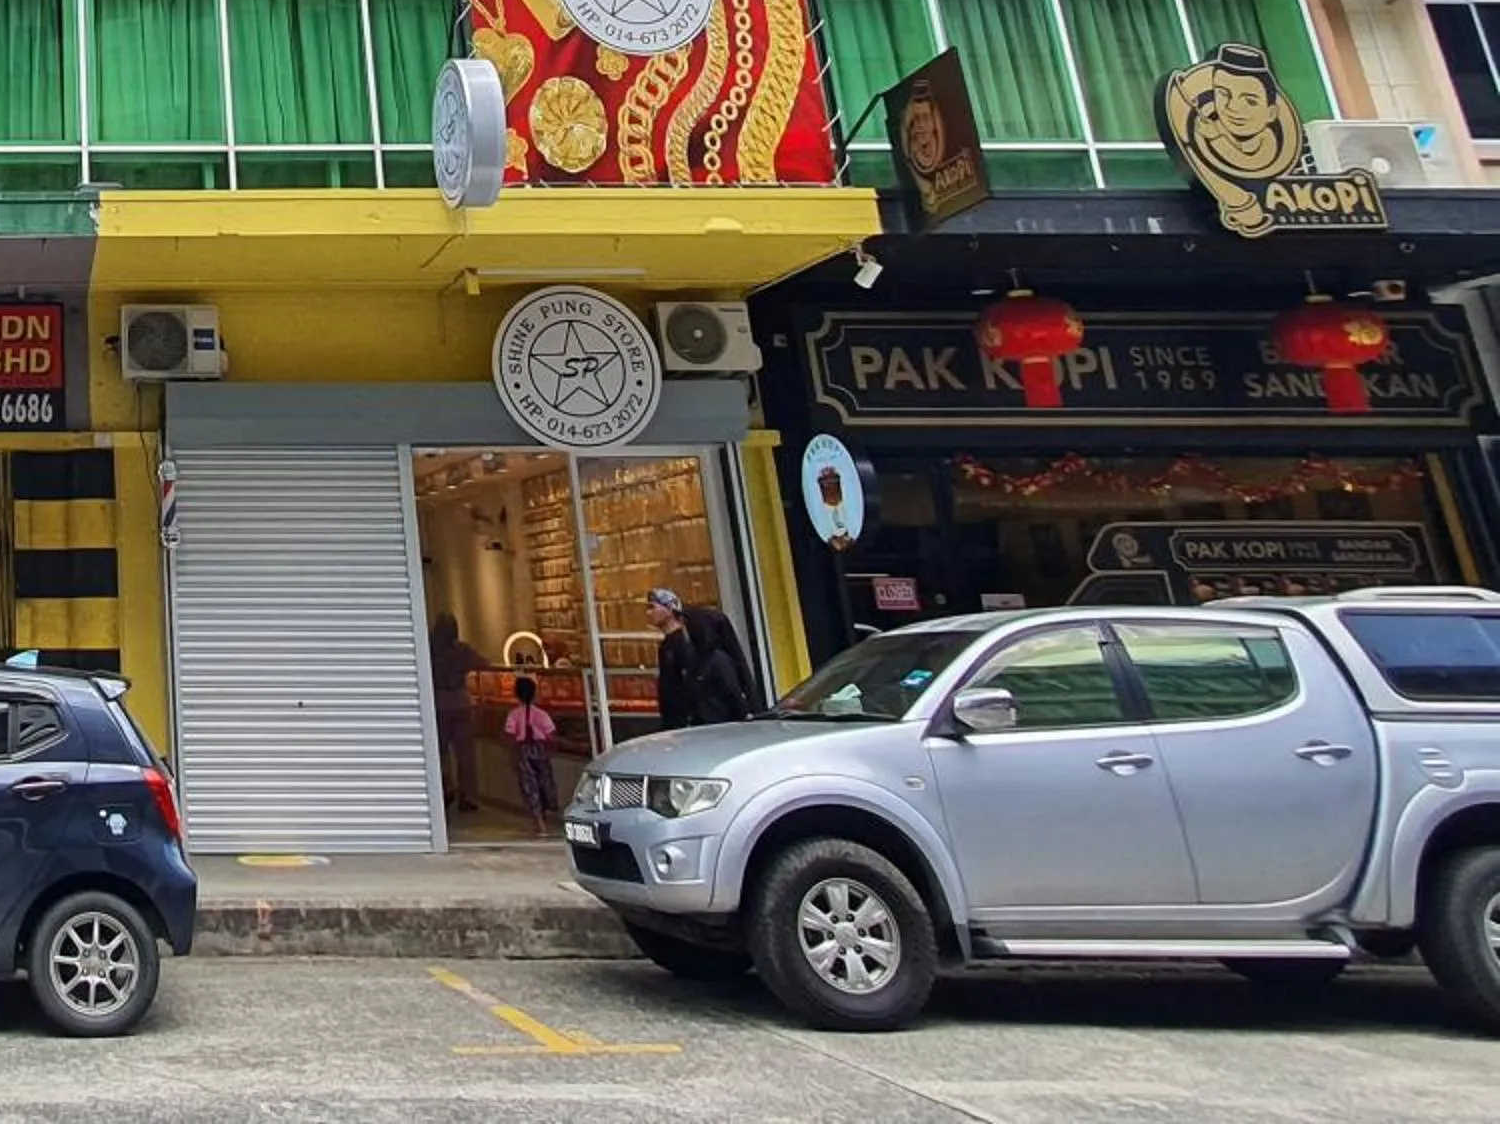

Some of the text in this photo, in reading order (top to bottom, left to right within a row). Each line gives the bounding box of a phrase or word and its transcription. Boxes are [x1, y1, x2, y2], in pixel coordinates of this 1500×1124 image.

[670, 3, 700, 35] 2072
[507, 300, 645, 374] SHINE PUNG STORE
[560, 357, 599, 378] SP
[850, 346, 1119, 390] PAK KPI
[1131, 346, 1213, 367] SINCE
[1136, 371, 1215, 391] 1969
[519, 393, 643, 439] HP: 014-673 2072
[1184, 541, 1227, 560] PAK
[1233, 541, 1286, 560] KOPI
